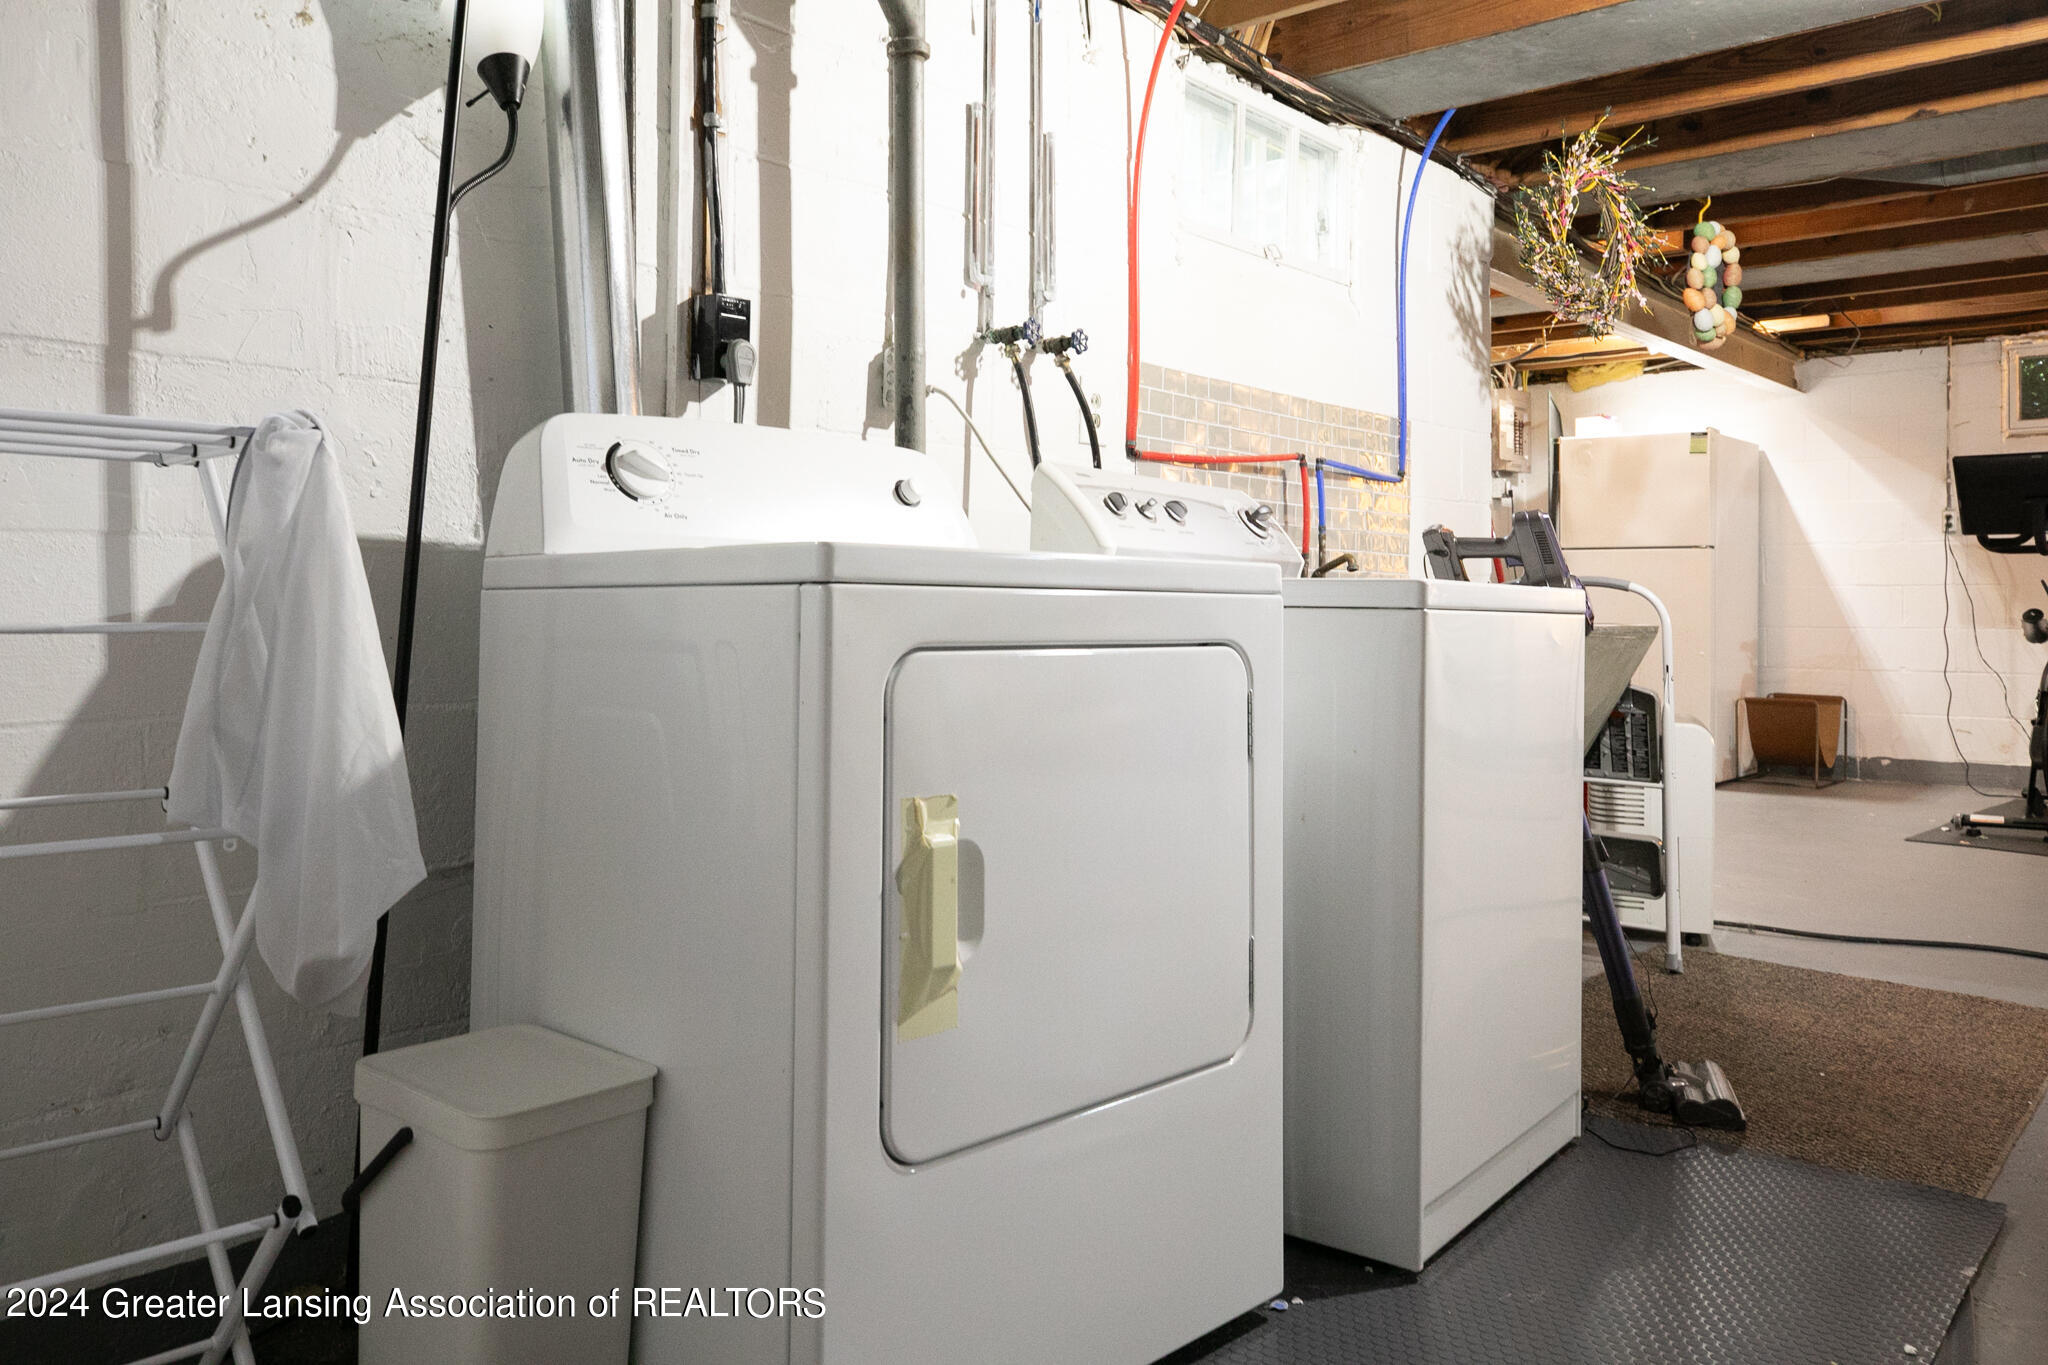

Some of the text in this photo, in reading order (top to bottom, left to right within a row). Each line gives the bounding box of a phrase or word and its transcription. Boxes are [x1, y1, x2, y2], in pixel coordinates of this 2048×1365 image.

[689, 448, 700, 456] Dry
[571, 456, 600, 465] Auto Dry
[674, 512, 688, 520] Only
